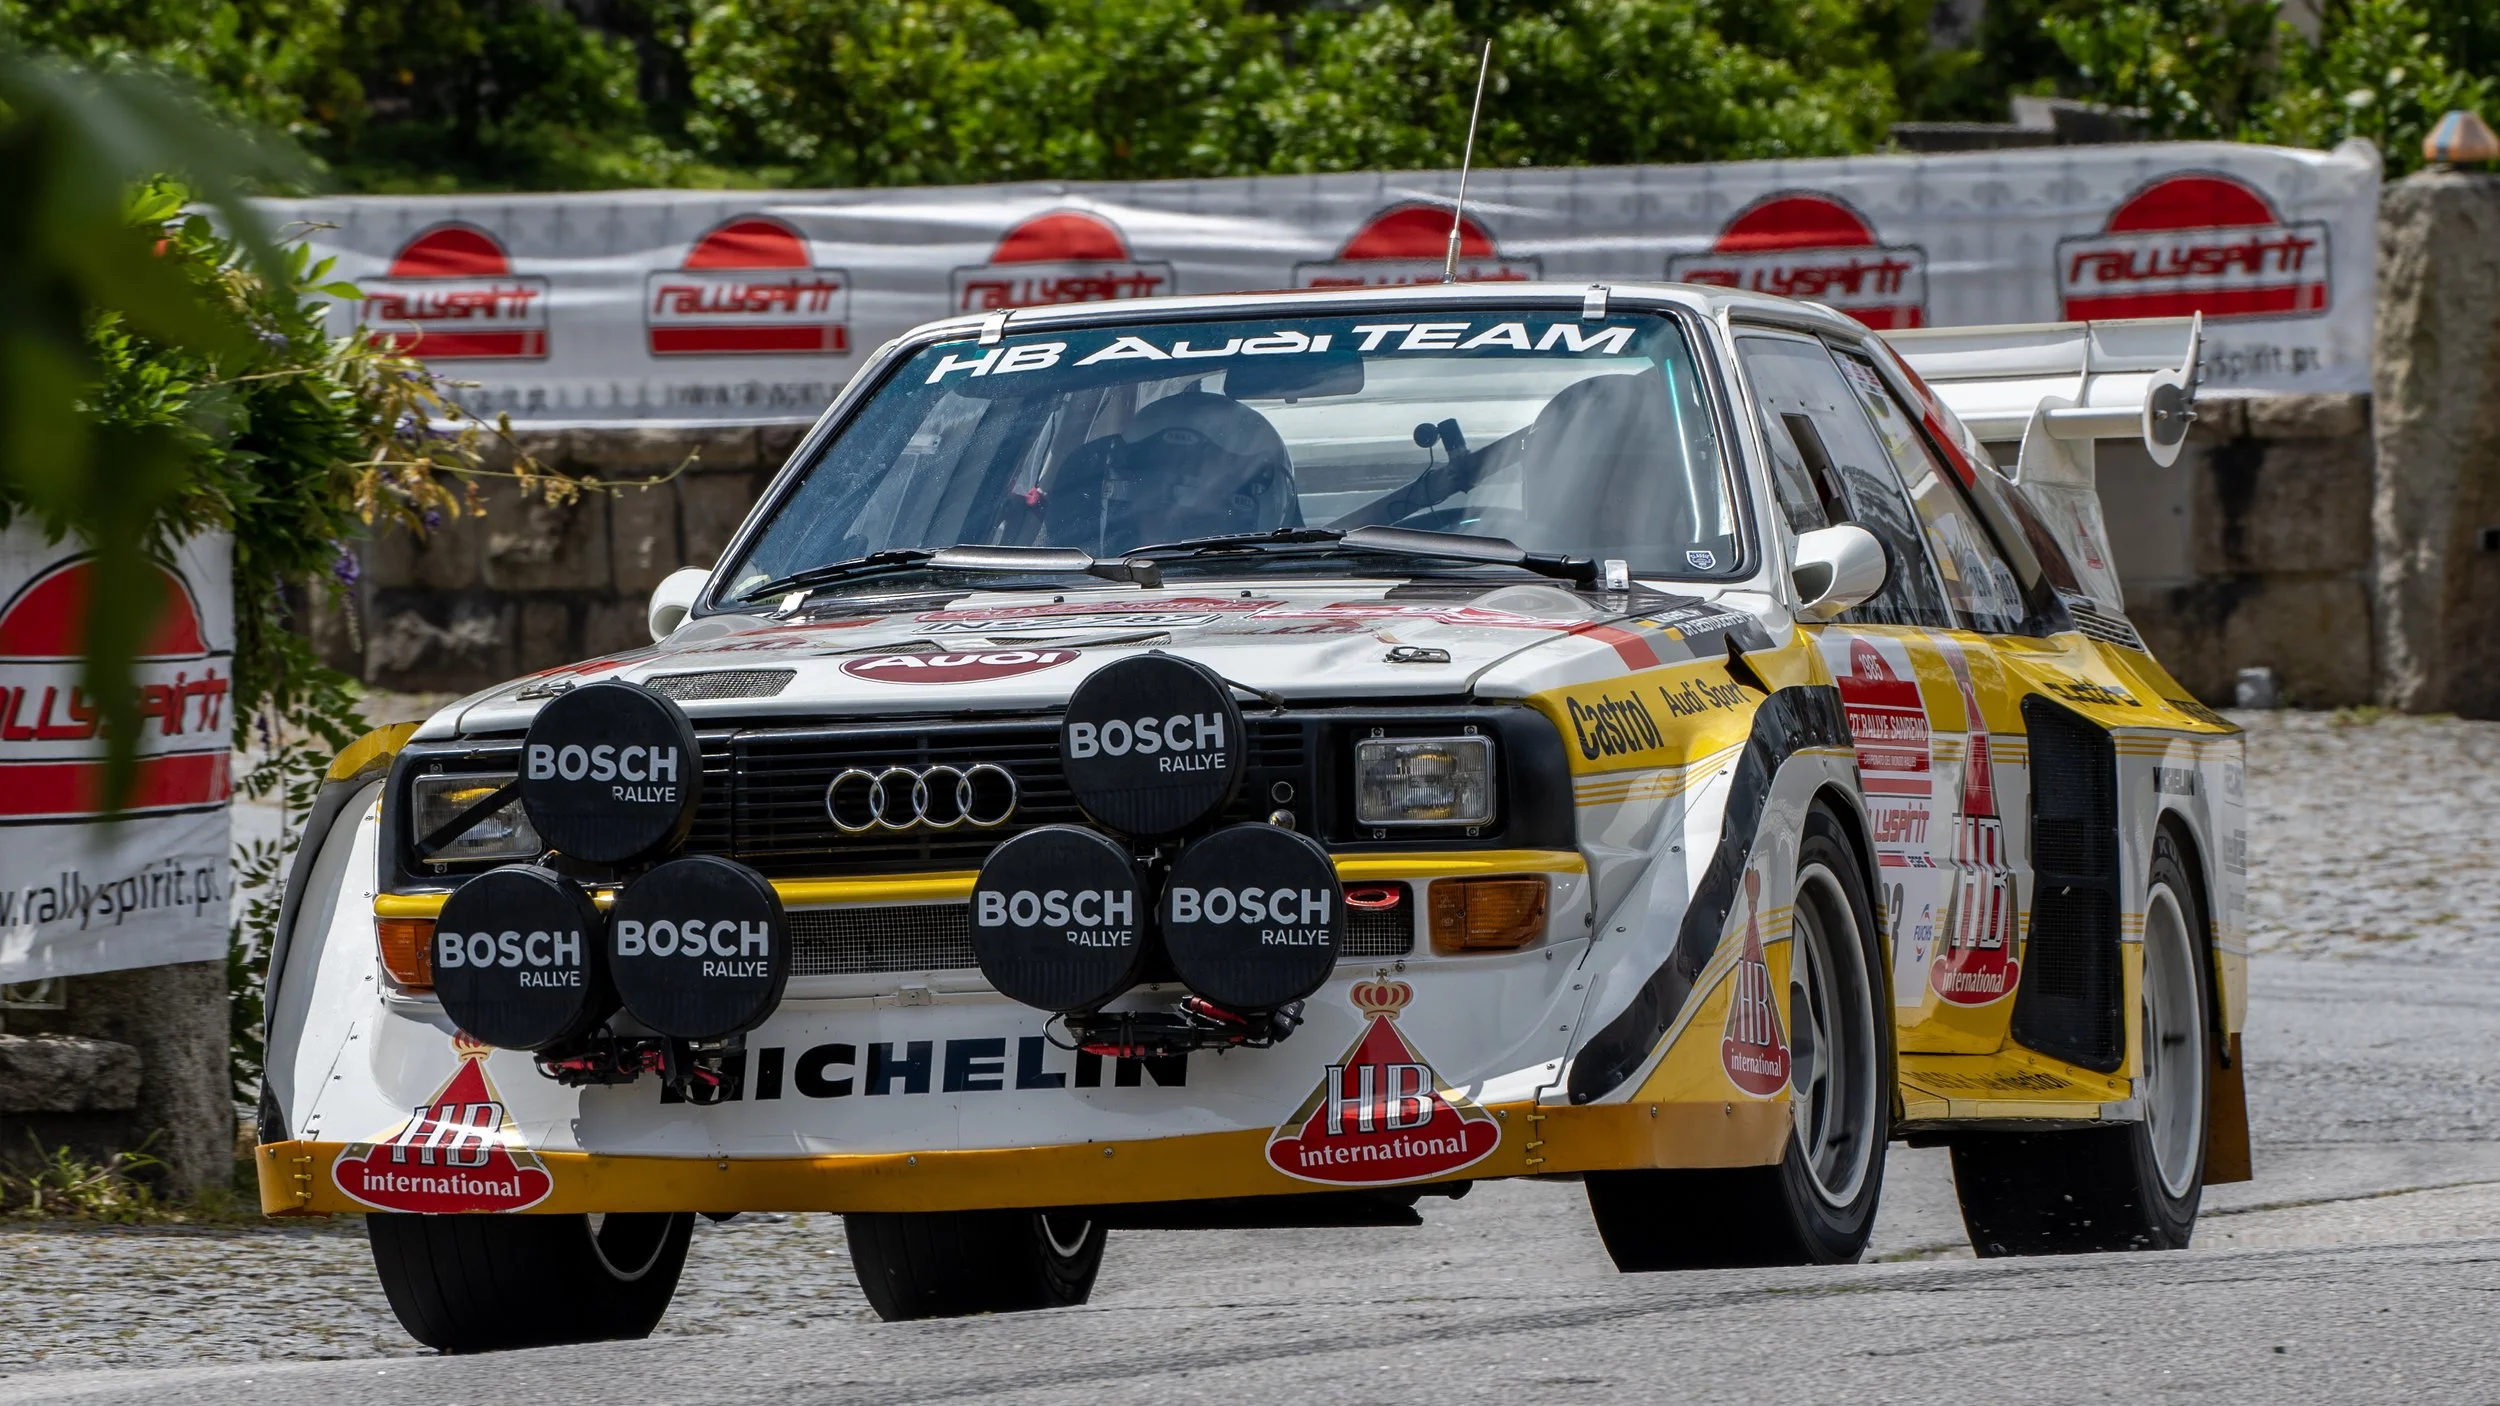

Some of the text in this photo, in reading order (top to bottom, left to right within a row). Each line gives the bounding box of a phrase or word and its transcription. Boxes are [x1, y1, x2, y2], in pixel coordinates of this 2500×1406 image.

[925, 341, 1067, 385] HB
[1351, 321, 1637, 355] TEAM
[1858, 653, 1884, 682] 1985
[1068, 712, 1225, 759] BOSCH
[1566, 678, 1752, 761] Castrol Audi Sport
[1861, 714, 1888, 739] RALLYE
[527, 743, 678, 783] BOSCH
[1159, 753, 1226, 773] RALLYE
[612, 785, 676, 803] RALLYE
[1950, 813, 2009, 949] HB
[977, 889, 1133, 927] BOSCH
[1171, 887, 1331, 925] BOSCH
[437, 930, 581, 968] BOSCH
[617, 919, 769, 957] BOSCH
[1067, 930, 1132, 948] RALLYE
[1261, 929, 1331, 947] RALLYE
[1913, 925, 1933, 942] FUCHS
[519, 970, 581, 988] RALLYE
[703, 960, 768, 978] RALLYE
[1942, 963, 2007, 994] international
[1738, 957, 1771, 1046] HB
[1731, 1049, 1782, 1078] international
[1325, 1062, 1437, 1136] HB
[390, 1100, 505, 1168] HB
[1299, 1129, 1468, 1167] international
[363, 1168, 522, 1198] international
